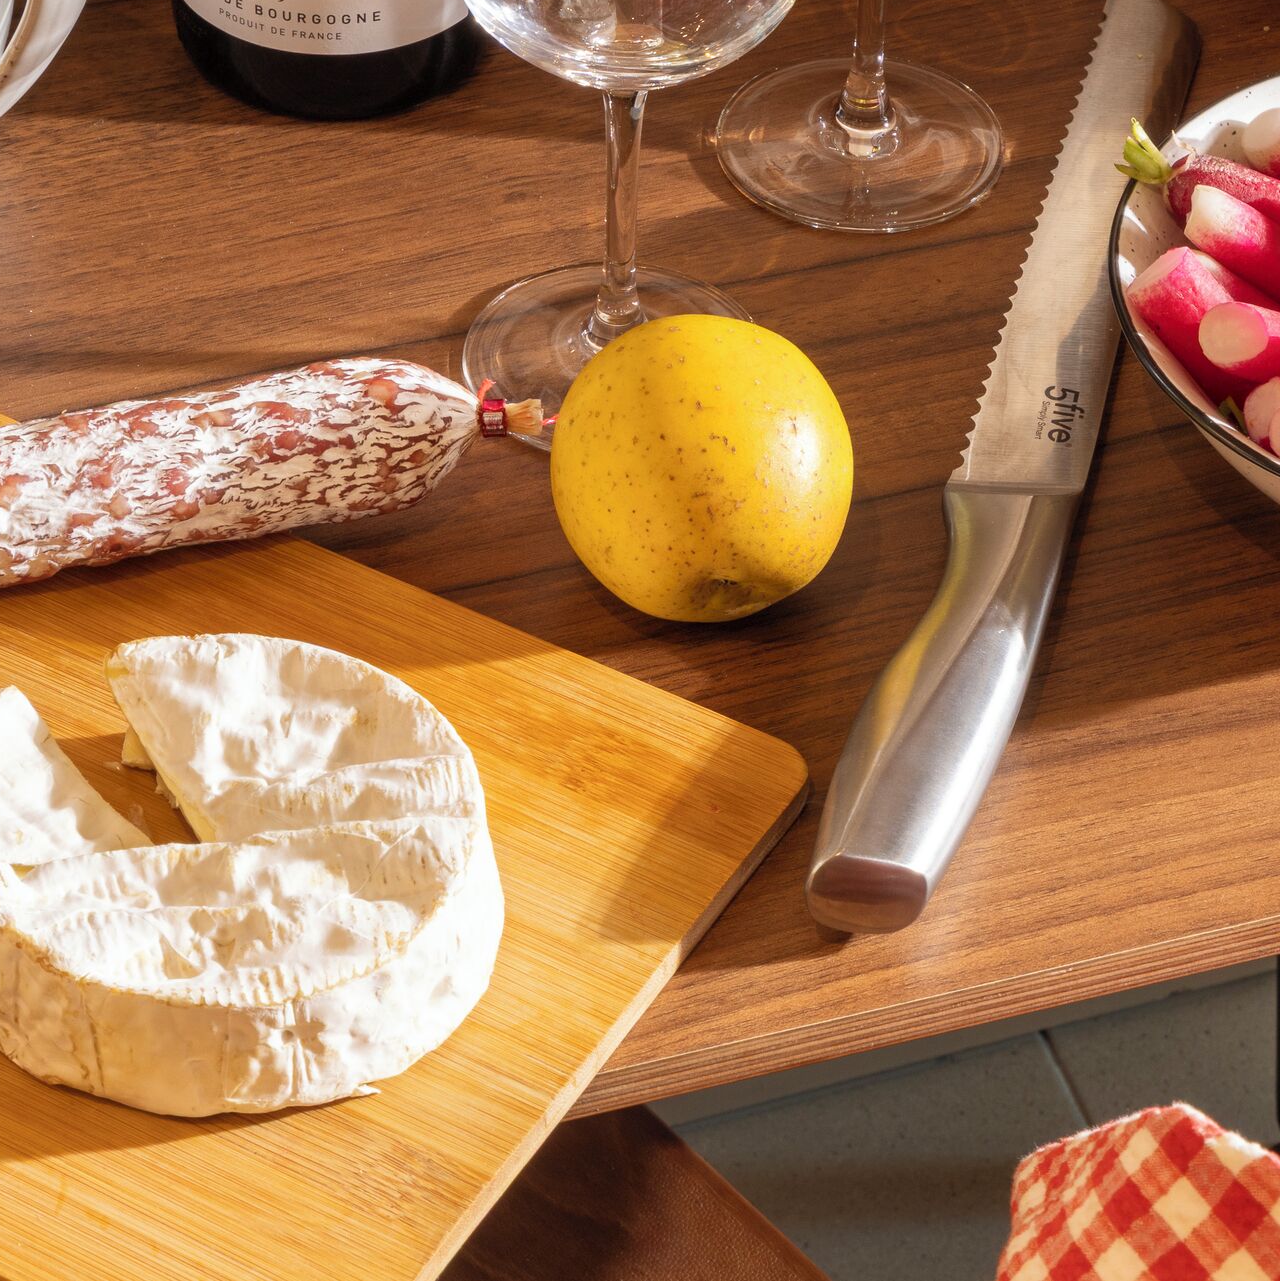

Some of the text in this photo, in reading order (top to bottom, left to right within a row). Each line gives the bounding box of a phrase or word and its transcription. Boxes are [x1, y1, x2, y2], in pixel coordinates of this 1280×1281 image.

[218, 7, 342, 41] PRODUIT DE FRANCE
[254, 4, 382, 25] BOURGOGNE
[1034, 400, 1051, 440] Simply Smart
[1044, 385, 1086, 443] 5five
